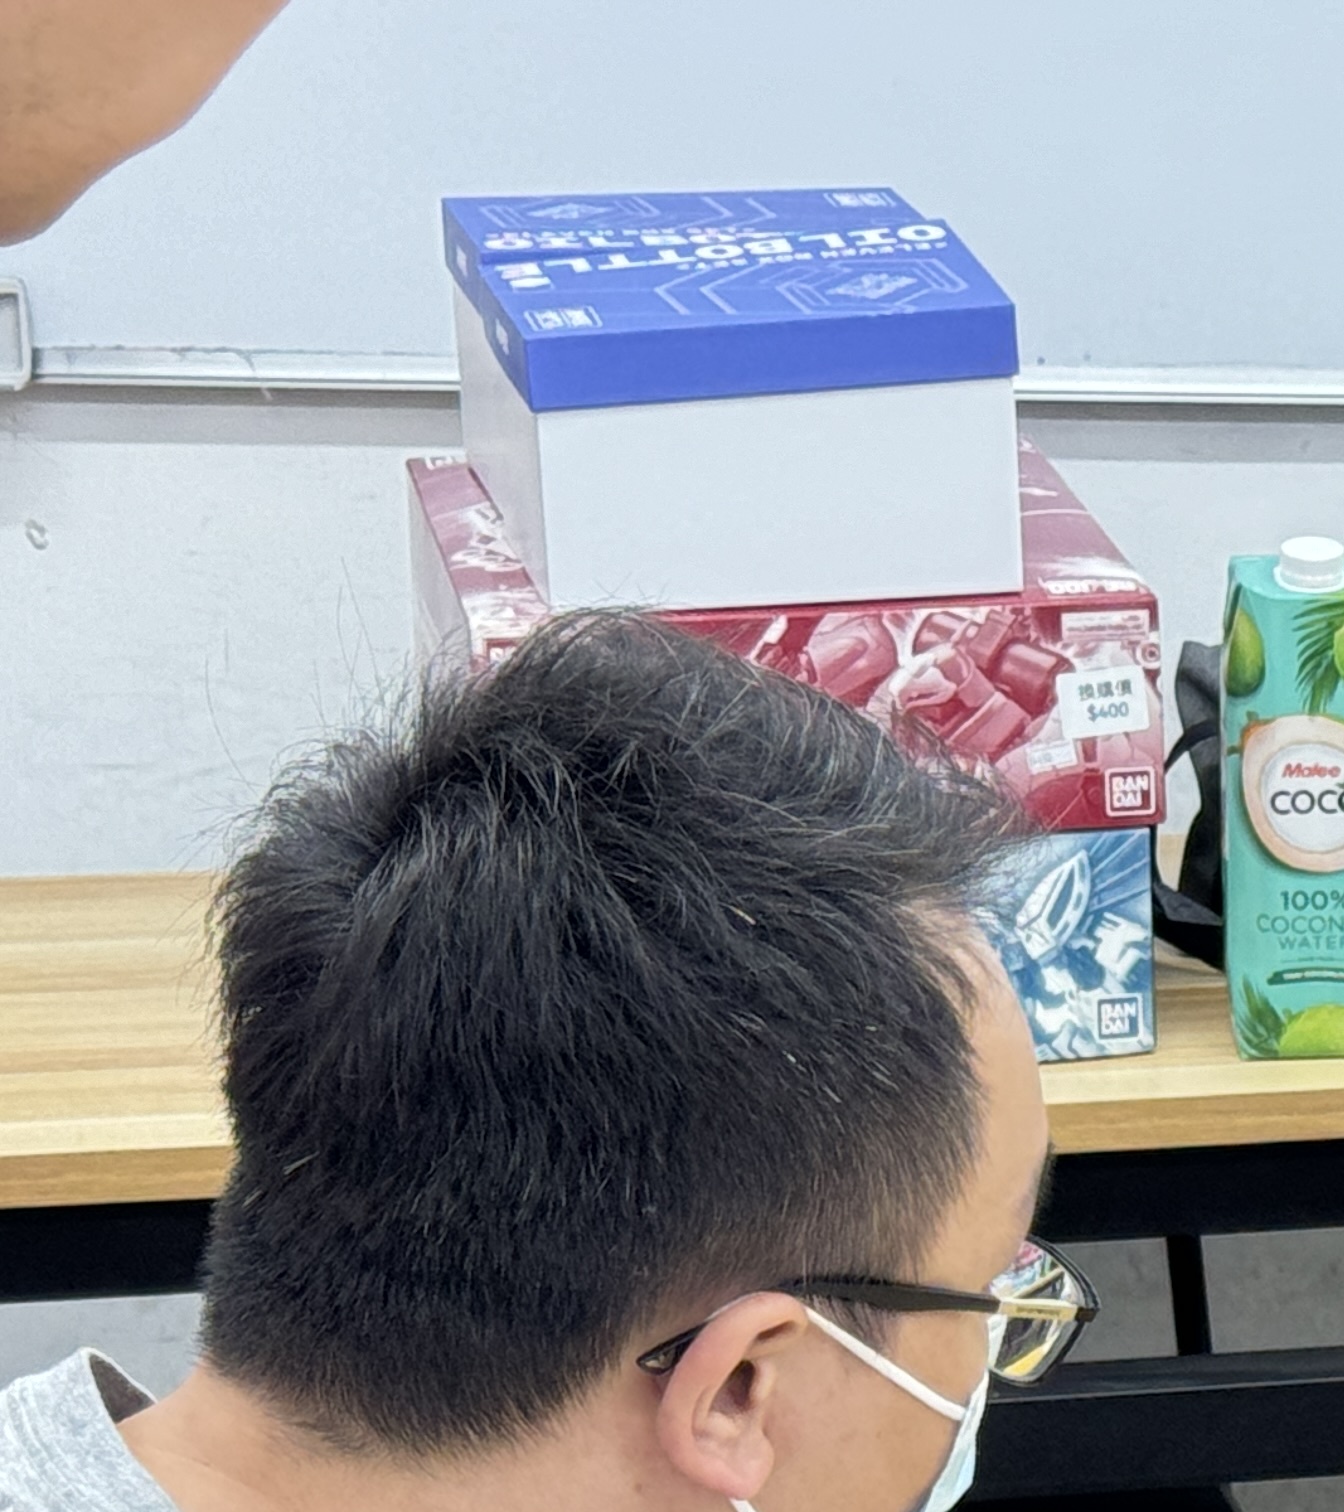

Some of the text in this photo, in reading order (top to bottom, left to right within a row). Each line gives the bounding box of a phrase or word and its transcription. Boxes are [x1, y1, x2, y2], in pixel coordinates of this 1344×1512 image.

[799, 225, 947, 249] OIL
[1087, 701, 1130, 723] $400
[1281, 763, 1341, 778] Malee
